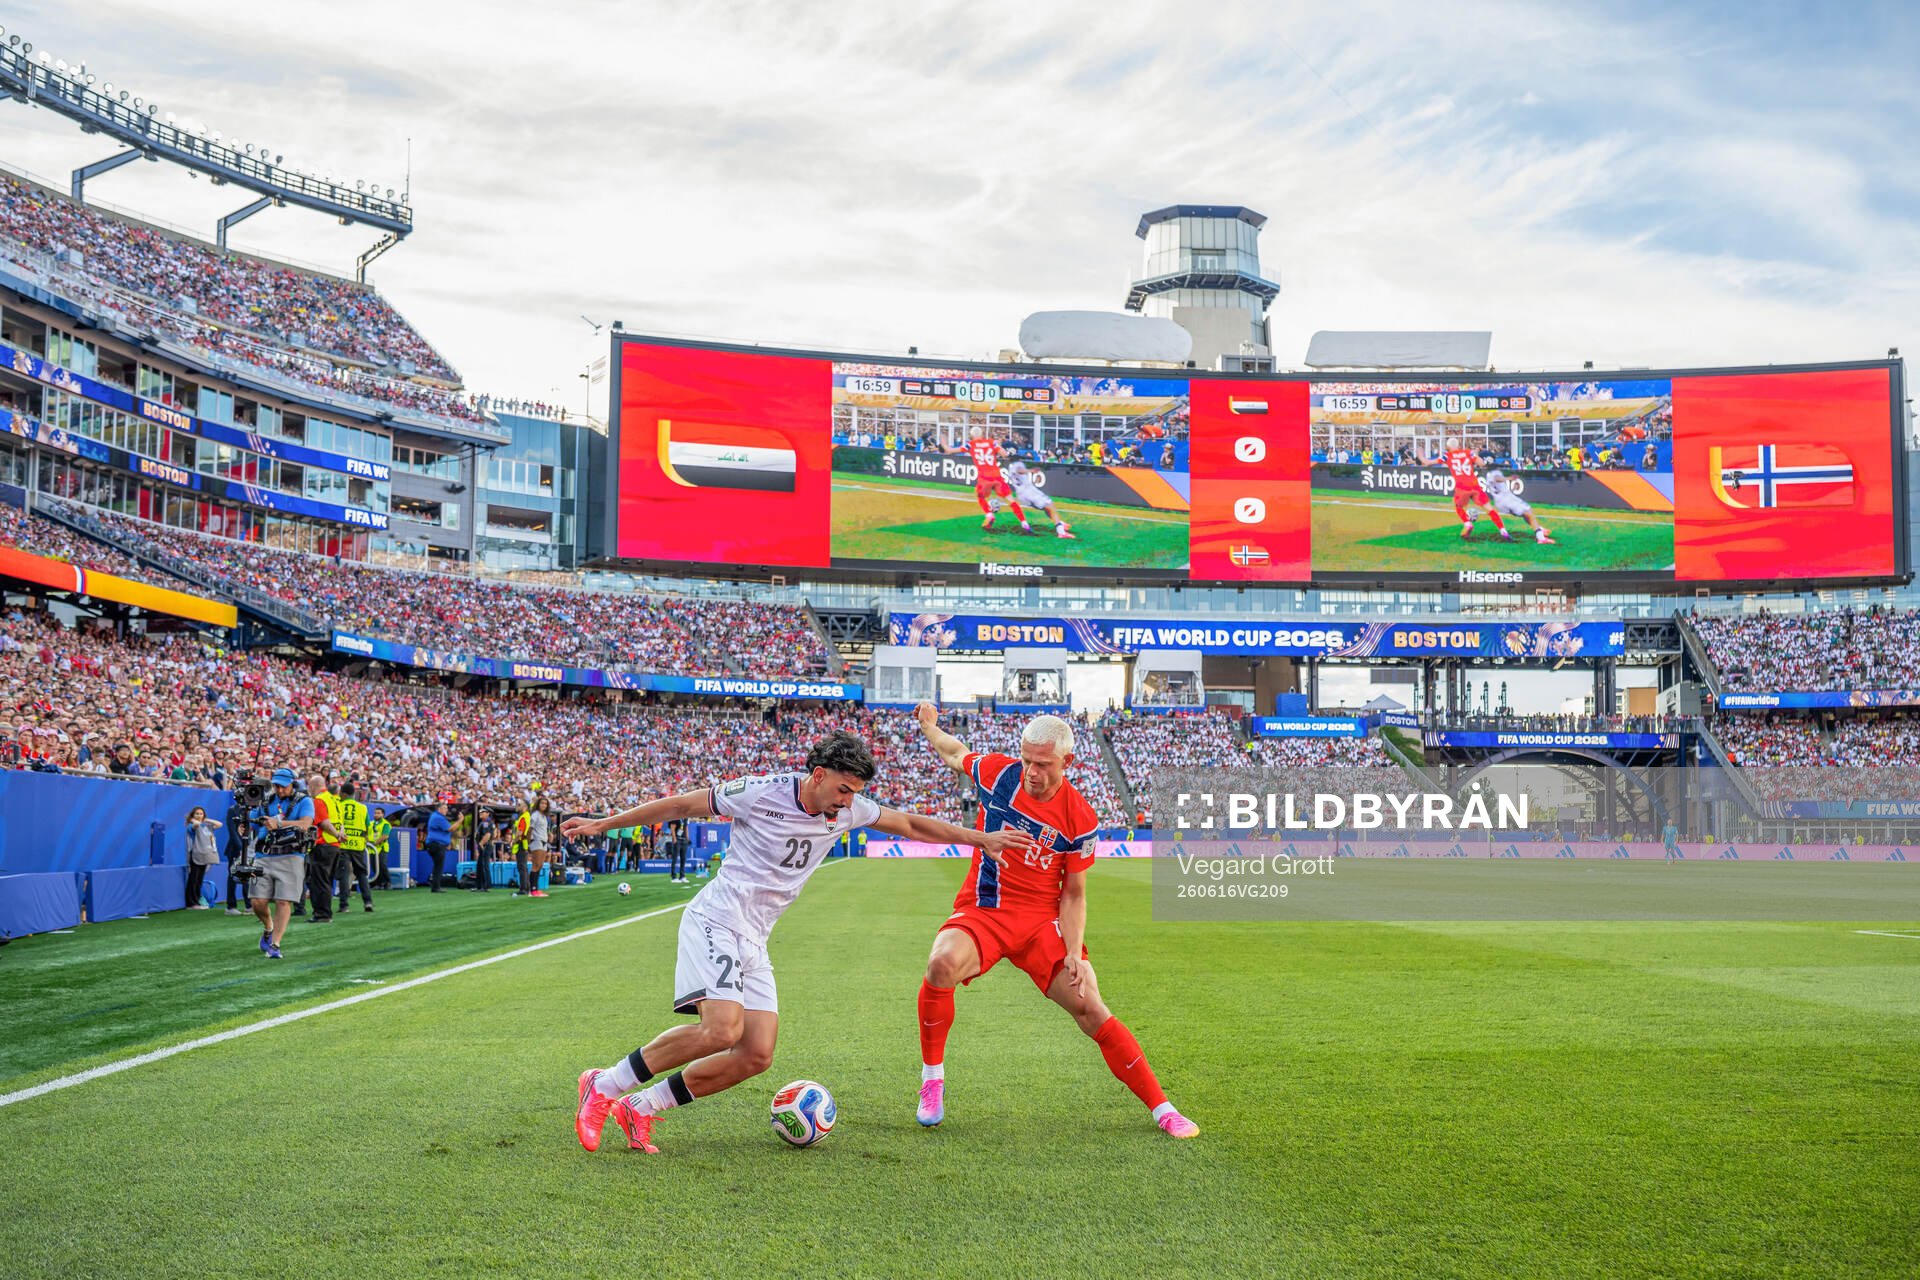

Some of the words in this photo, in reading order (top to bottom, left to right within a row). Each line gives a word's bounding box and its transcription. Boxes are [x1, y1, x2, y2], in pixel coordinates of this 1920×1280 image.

[855, 379, 892, 393] 16:59
[959, 386, 967, 397] 0
[988, 388, 996, 399] 0
[1331, 397, 1368, 410] 16:59
[1435, 398, 1443, 410] 0
[1464, 399, 1472, 410] 0
[1480, 399, 1499, 410] NOR
[143, 401, 191, 430] BOSTON
[141, 458, 188, 485] BOSTON
[347, 459, 372, 476] FIFA
[900, 454, 940, 477] Inter
[1377, 468, 1416, 489] Inter
[345, 508, 370, 525] FIFA
[979, 563, 1043, 576] Hisense
[1459, 571, 1523, 583] Hisense
[977, 624, 1064, 643] BOSTON
[1113, 627, 1155, 646] FIFA
[1156, 629, 1229, 647] WORLD
[1232, 631, 1268, 647] CUP
[1274, 631, 1343, 648] 2026
[1394, 631, 1479, 648] BOSTON
[513, 664, 562, 681] BOSTON
[694, 678, 723, 692] FIFA
[723, 681, 769, 695] WORLD
[770, 683, 796, 696] CUP
[798, 685, 844, 697] 2026
[1265, 723, 1282, 731] FIFA
[1283, 723, 1311, 731] WORLD
[1312, 723, 1328, 732] CUP
[1328, 724, 1356, 732] 2026
[1385, 716, 1418, 726] BOSTON
[1497, 735, 1518, 745] FIFA
[1519, 735, 1553, 745] WORLD
[1554, 736, 1573, 745] CUP
[1575, 736, 1608, 745] 2026
[765, 810, 784, 820] JAKO
[1866, 803, 1900, 816] FIFA
[780, 838, 812, 869] 23
